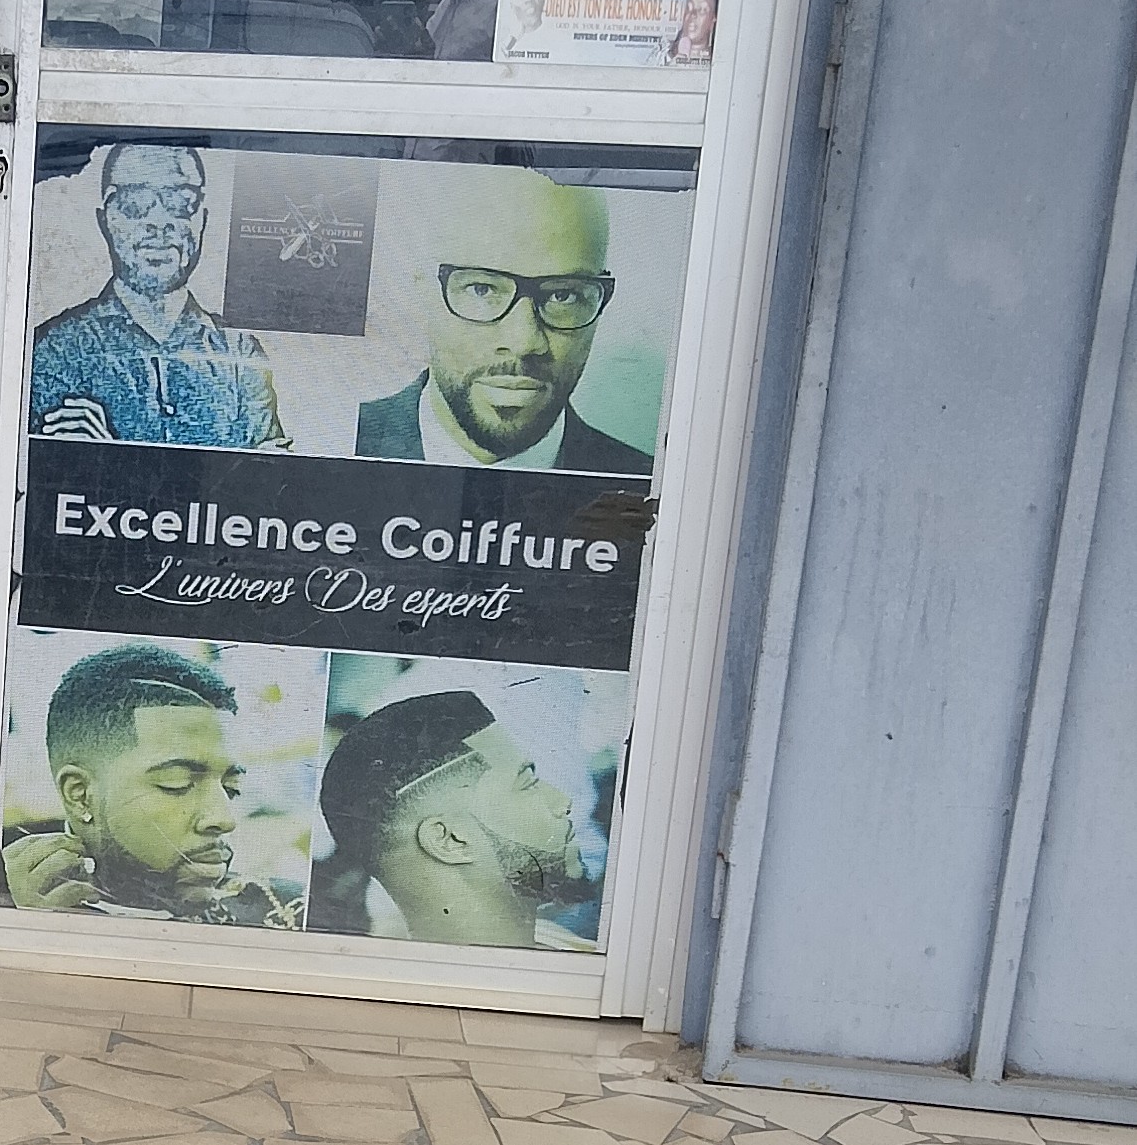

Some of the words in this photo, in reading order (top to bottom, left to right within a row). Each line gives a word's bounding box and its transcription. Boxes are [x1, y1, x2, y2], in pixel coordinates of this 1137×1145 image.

[54, 493, 357, 555] Excellence
[380, 515, 620, 574] Coiffure
[115, 555, 296, 607] L'univers
[304, 566, 396, 613] Des
[402, 582, 524, 628] esperts
